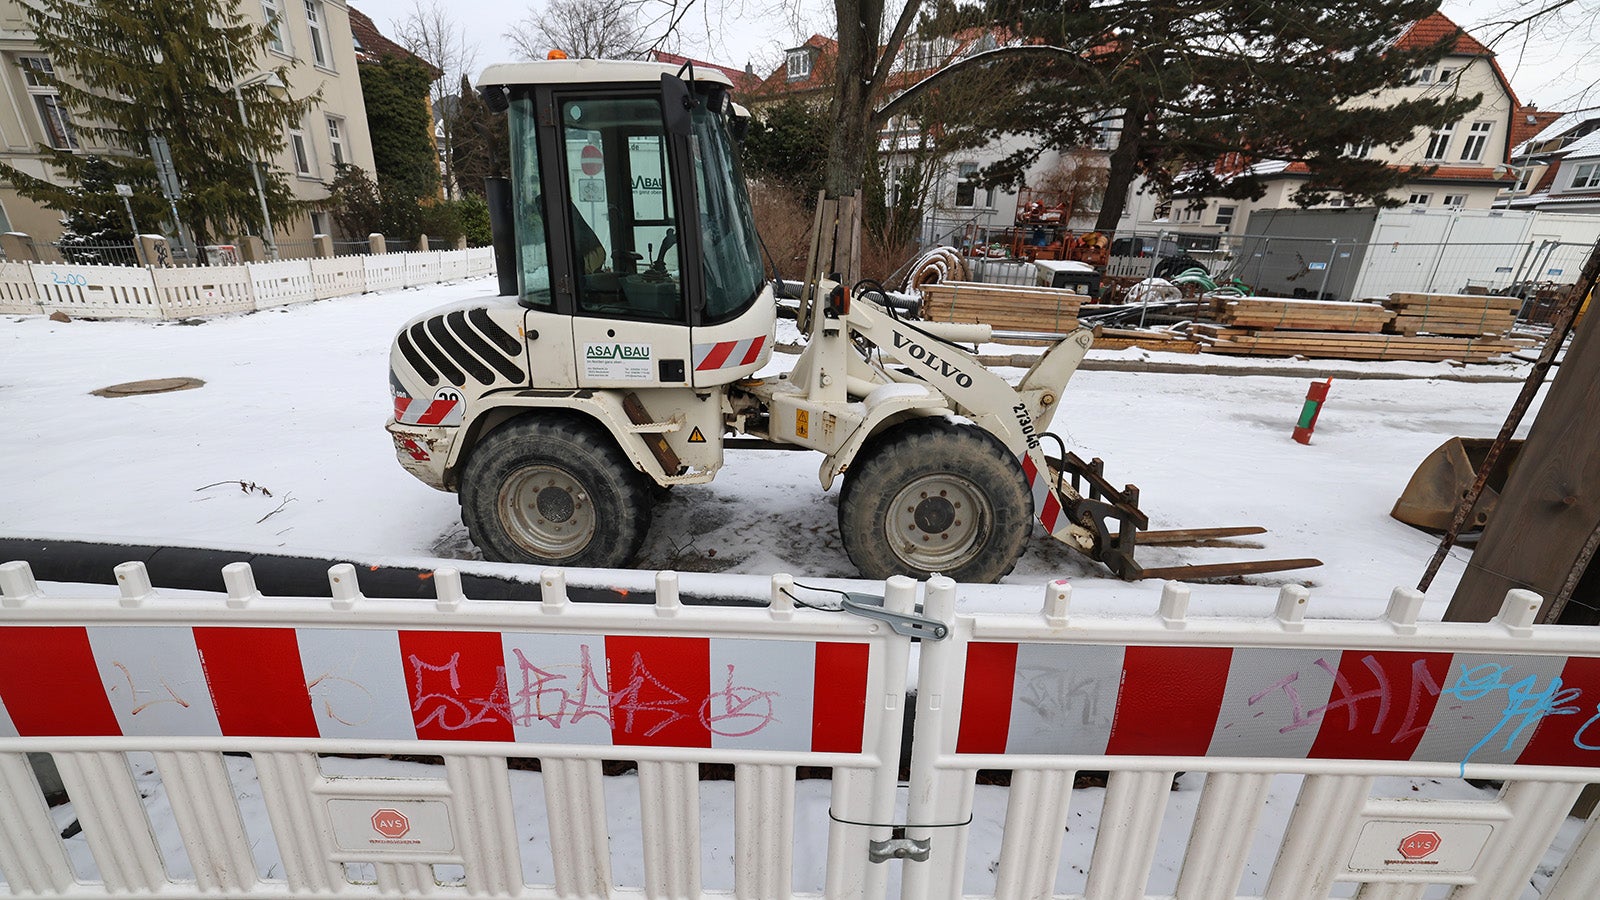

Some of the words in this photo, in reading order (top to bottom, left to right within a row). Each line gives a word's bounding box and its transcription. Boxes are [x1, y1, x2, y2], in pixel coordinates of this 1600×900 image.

[892, 329, 973, 389] VOLVO
[1012, 402, 1040, 450] 273046
[379, 819, 403, 828] AVS
[1407, 840, 1433, 850] AVS
